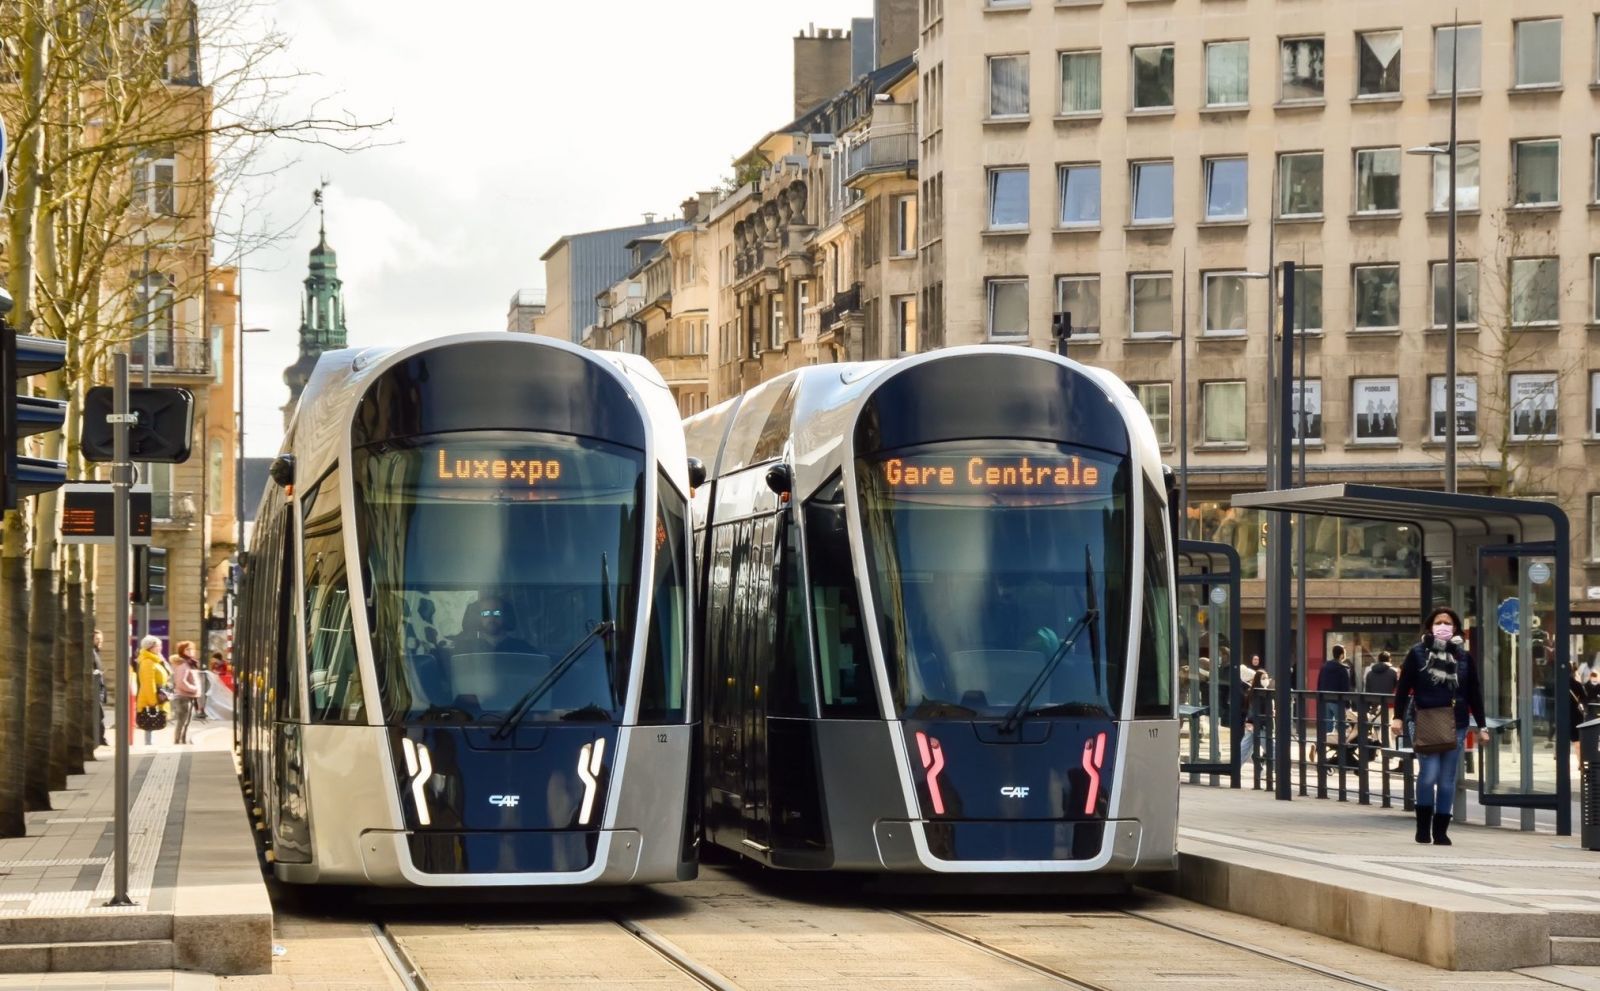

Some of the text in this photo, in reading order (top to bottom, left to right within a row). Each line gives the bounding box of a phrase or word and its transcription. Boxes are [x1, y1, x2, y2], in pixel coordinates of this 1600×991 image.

[439, 449, 560, 485] Luxexpo
[886, 456, 1099, 486] Gare Centrale
[1341, 616, 1383, 625] MOSQUITO
[657, 734, 667, 743] 122
[1149, 728, 1158, 737] 117
[1000, 786, 1030, 798] CAF
[488, 795, 520, 807] CAF
